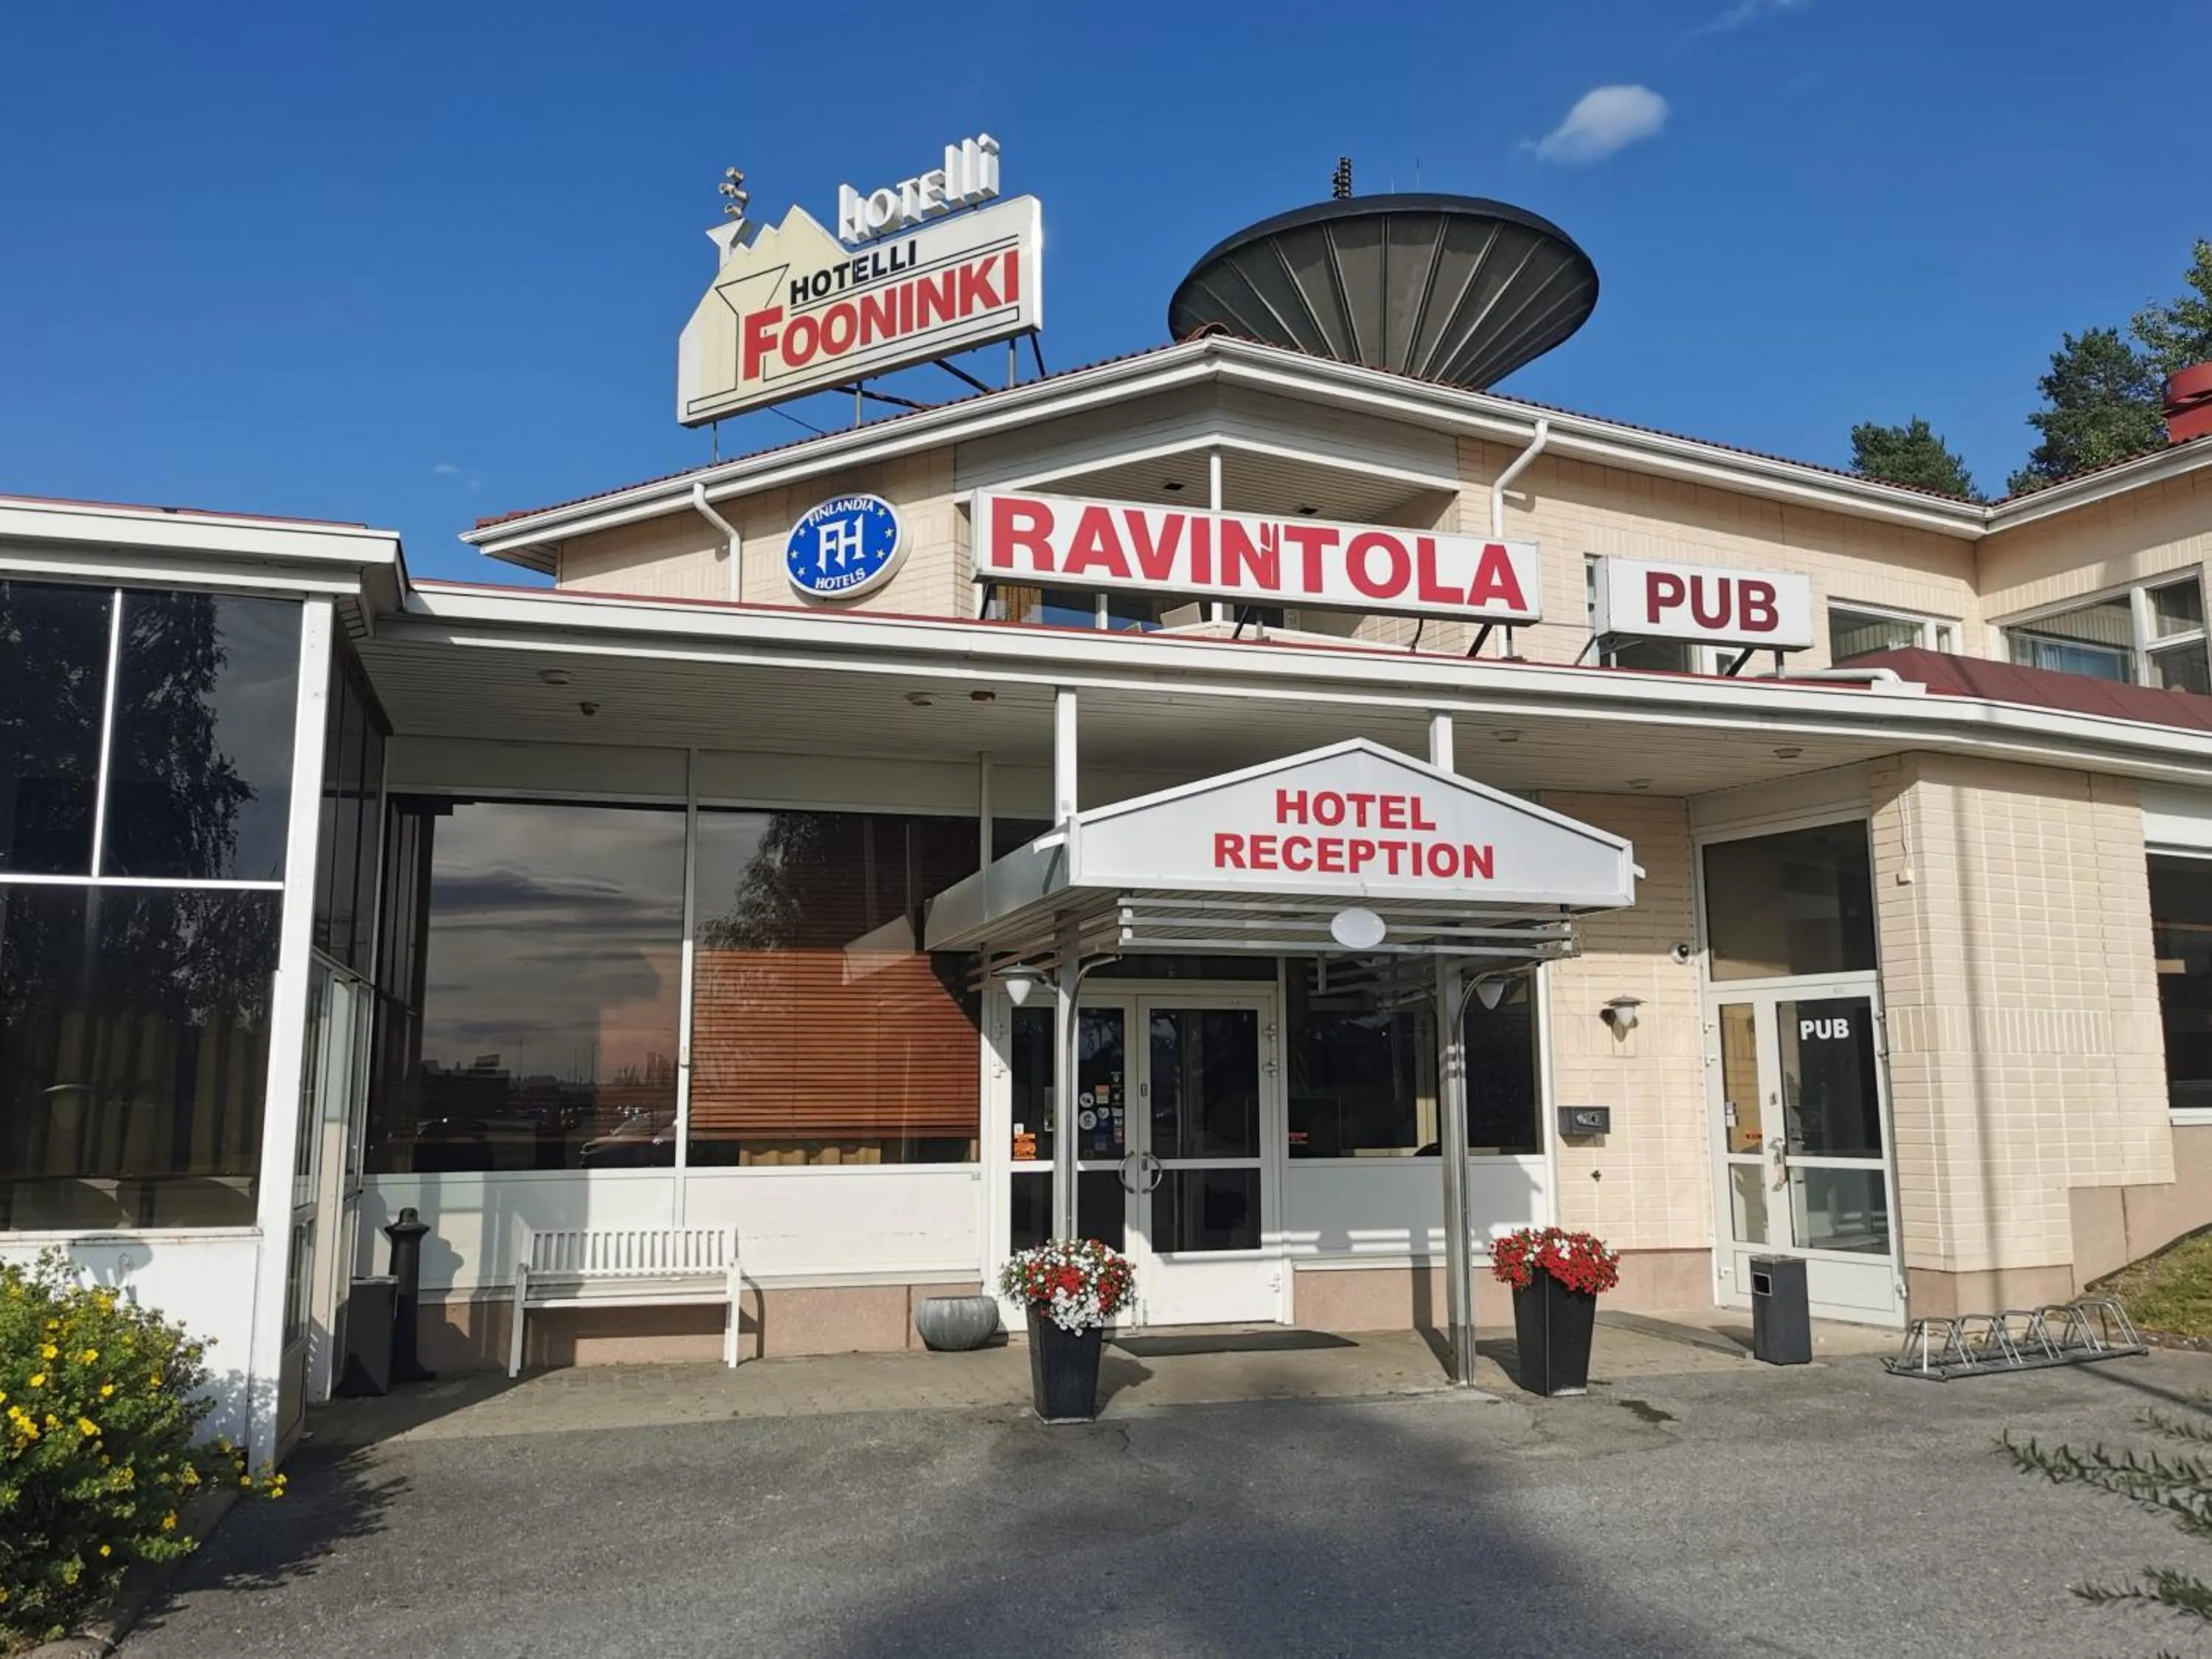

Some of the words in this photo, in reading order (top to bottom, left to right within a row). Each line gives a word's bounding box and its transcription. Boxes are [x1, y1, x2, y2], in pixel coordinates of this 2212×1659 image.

[790, 240, 917, 305] HOTELLI
[742, 249, 1020, 380] FOONINKI
[809, 498, 874, 526] FINLANDIA
[991, 497, 1528, 611] RAVINTOLA
[815, 567, 866, 590] HOTELS
[1646, 571, 1779, 632] PUB
[1276, 789, 1436, 831] HOTEL
[1214, 832, 1495, 879] RECEPTION
[1800, 1018, 1850, 1040] PUB
